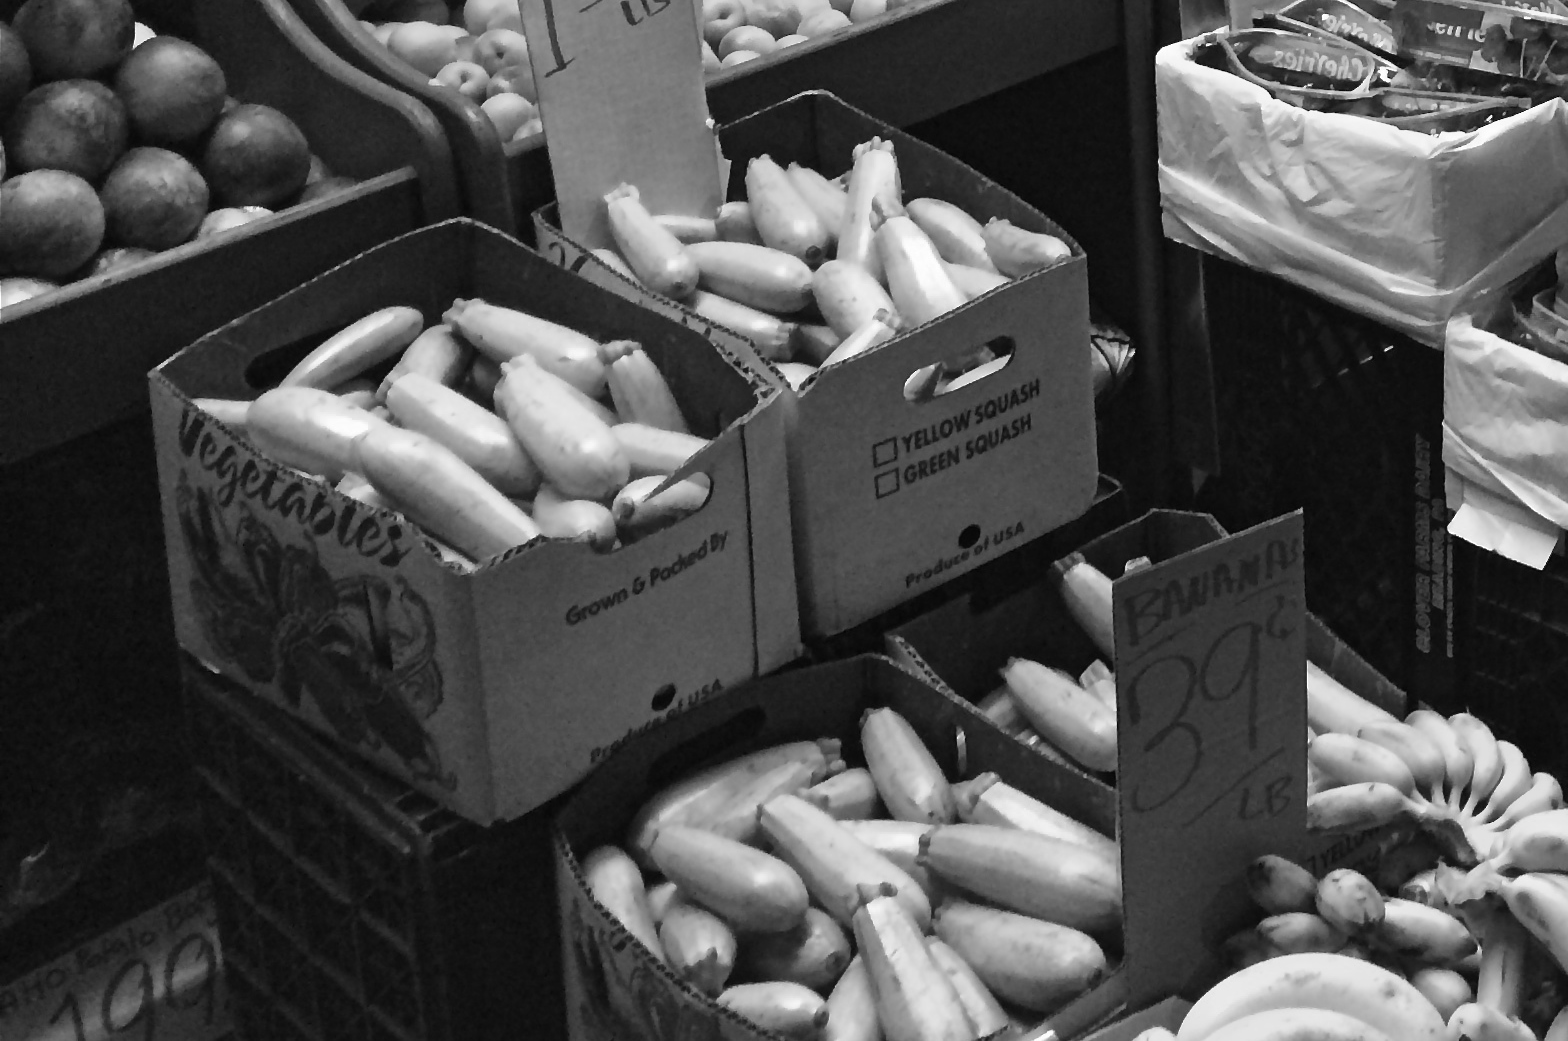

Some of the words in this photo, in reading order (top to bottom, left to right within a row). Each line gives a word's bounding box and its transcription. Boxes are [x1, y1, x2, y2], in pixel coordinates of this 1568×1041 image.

[901, 409, 972, 453] YELLOW
[974, 377, 1041, 425] SQUASH
[903, 444, 961, 485] GREEN
[964, 412, 1032, 460] SQUASH
[178, 408, 412, 568] Vegetables
[564, 586, 629, 626] Grown
[650, 538, 708, 587] Packed
[904, 549, 970, 589] Produce
[973, 534, 990, 556] of
[992, 520, 1025, 546] USA
[1124, 538, 1299, 646] BANANAS
[687, 677, 724, 708] USA
